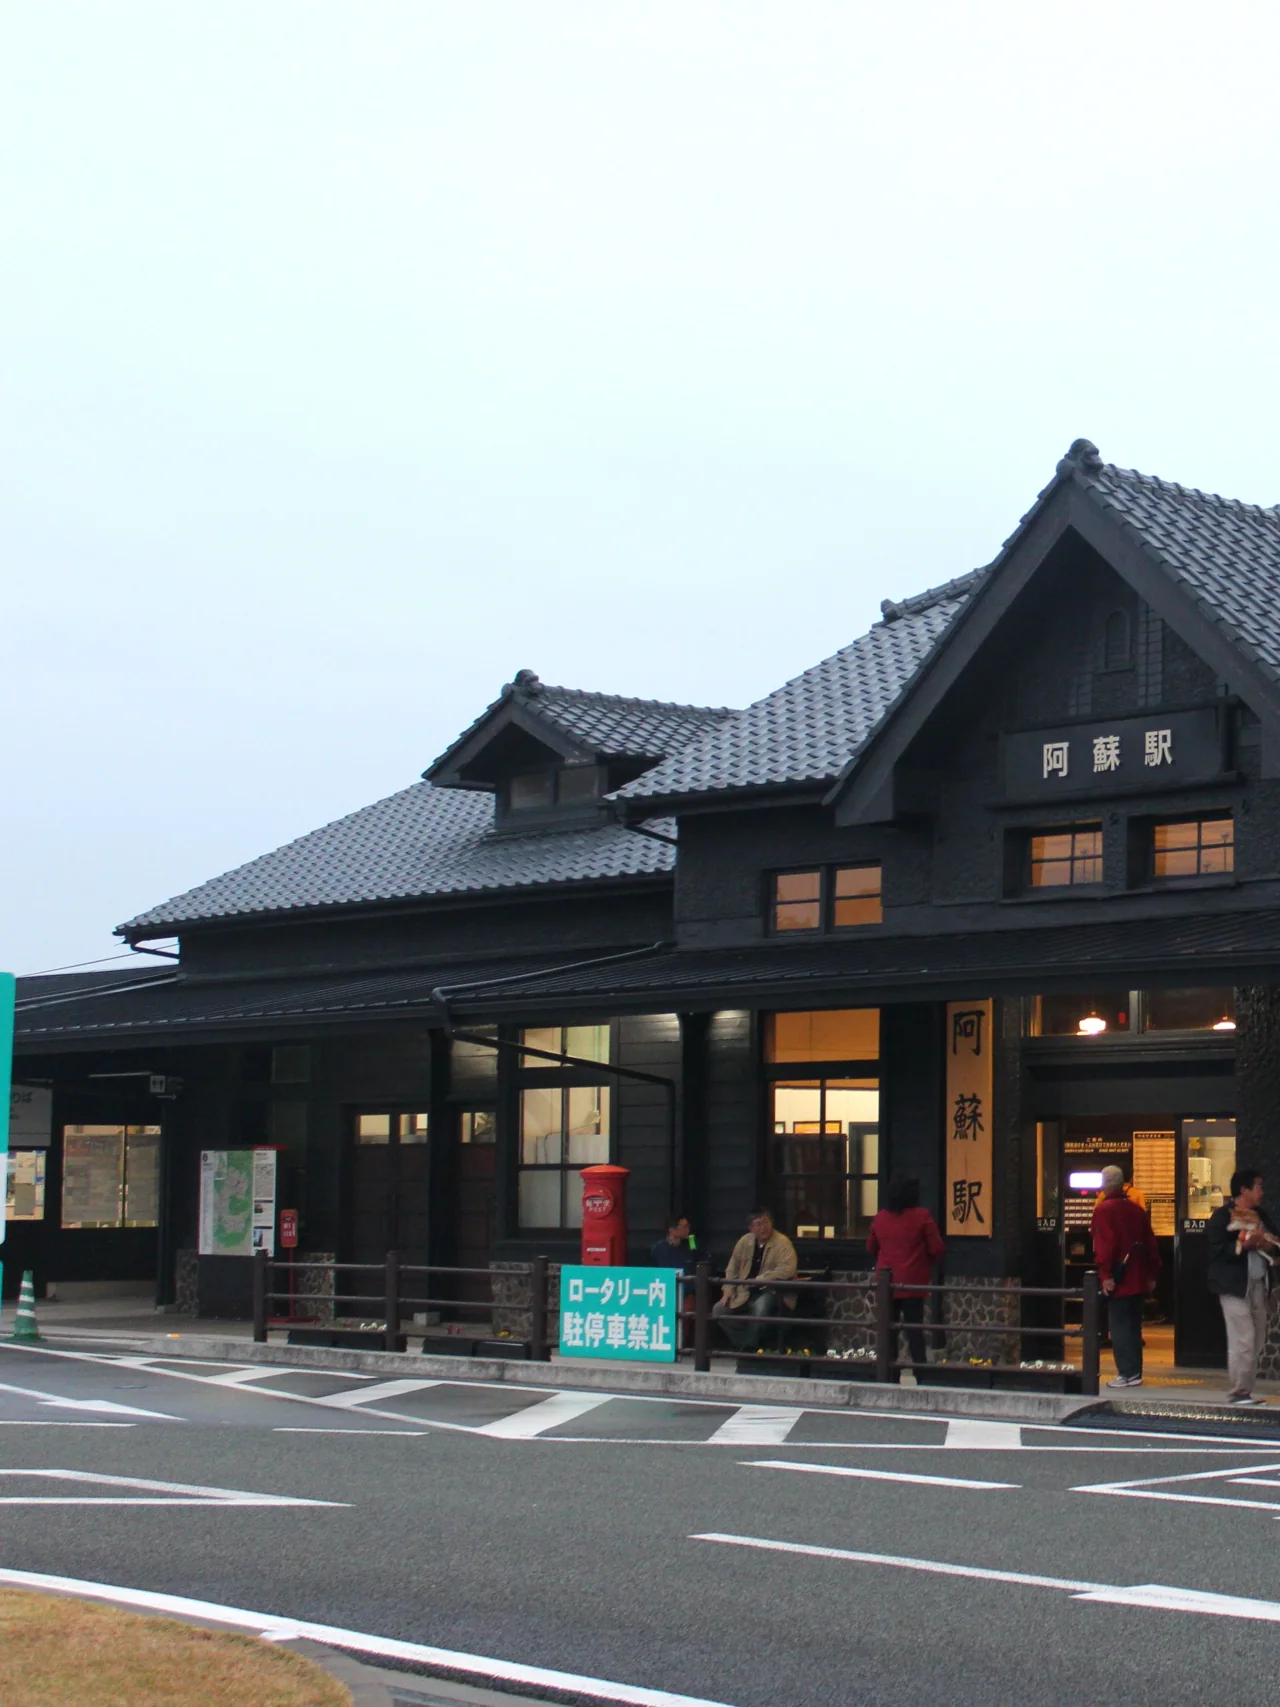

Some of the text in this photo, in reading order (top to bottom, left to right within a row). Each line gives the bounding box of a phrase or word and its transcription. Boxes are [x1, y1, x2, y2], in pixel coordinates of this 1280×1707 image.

[1042, 729, 1173, 779] 阿蘇駅
[952, 1010, 985, 1224] 阿蘇駅
[568, 1278, 667, 1308] ロータリー内
[562, 1311, 672, 1351] 駐停車禁止
